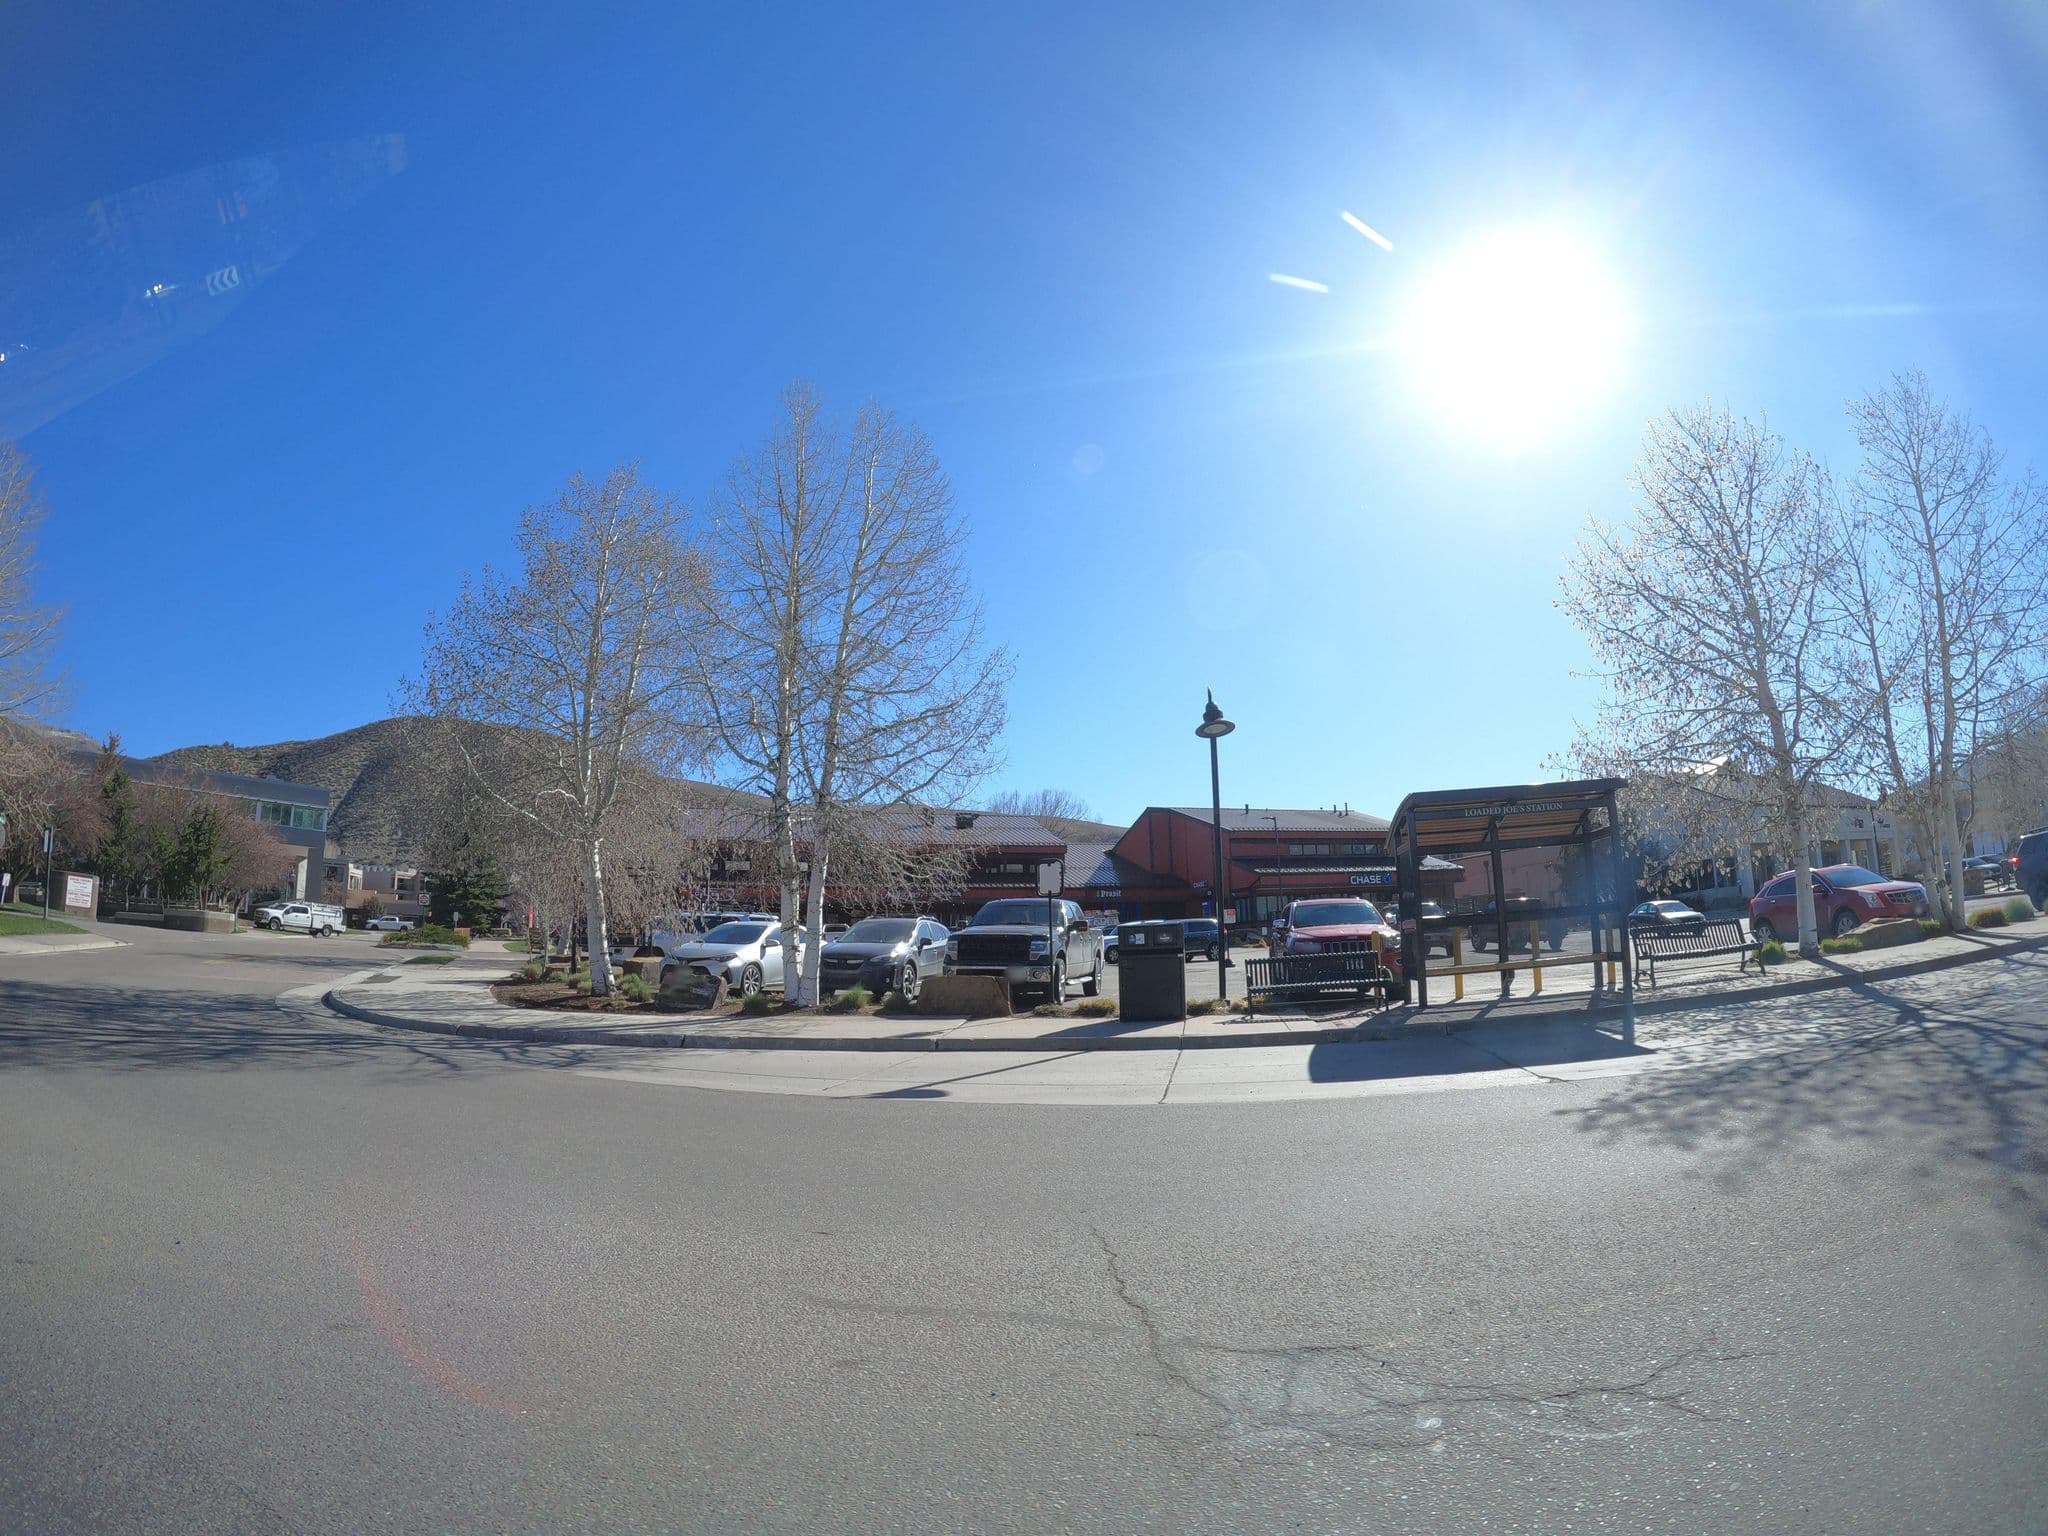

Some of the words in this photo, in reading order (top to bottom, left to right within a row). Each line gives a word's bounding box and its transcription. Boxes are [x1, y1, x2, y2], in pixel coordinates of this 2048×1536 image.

[1465, 807, 1501, 817] LOADED
[1503, 804, 1526, 815] JOE'S
[1526, 802, 1563, 813] STATION
[1350, 875, 1382, 885] CHASE
